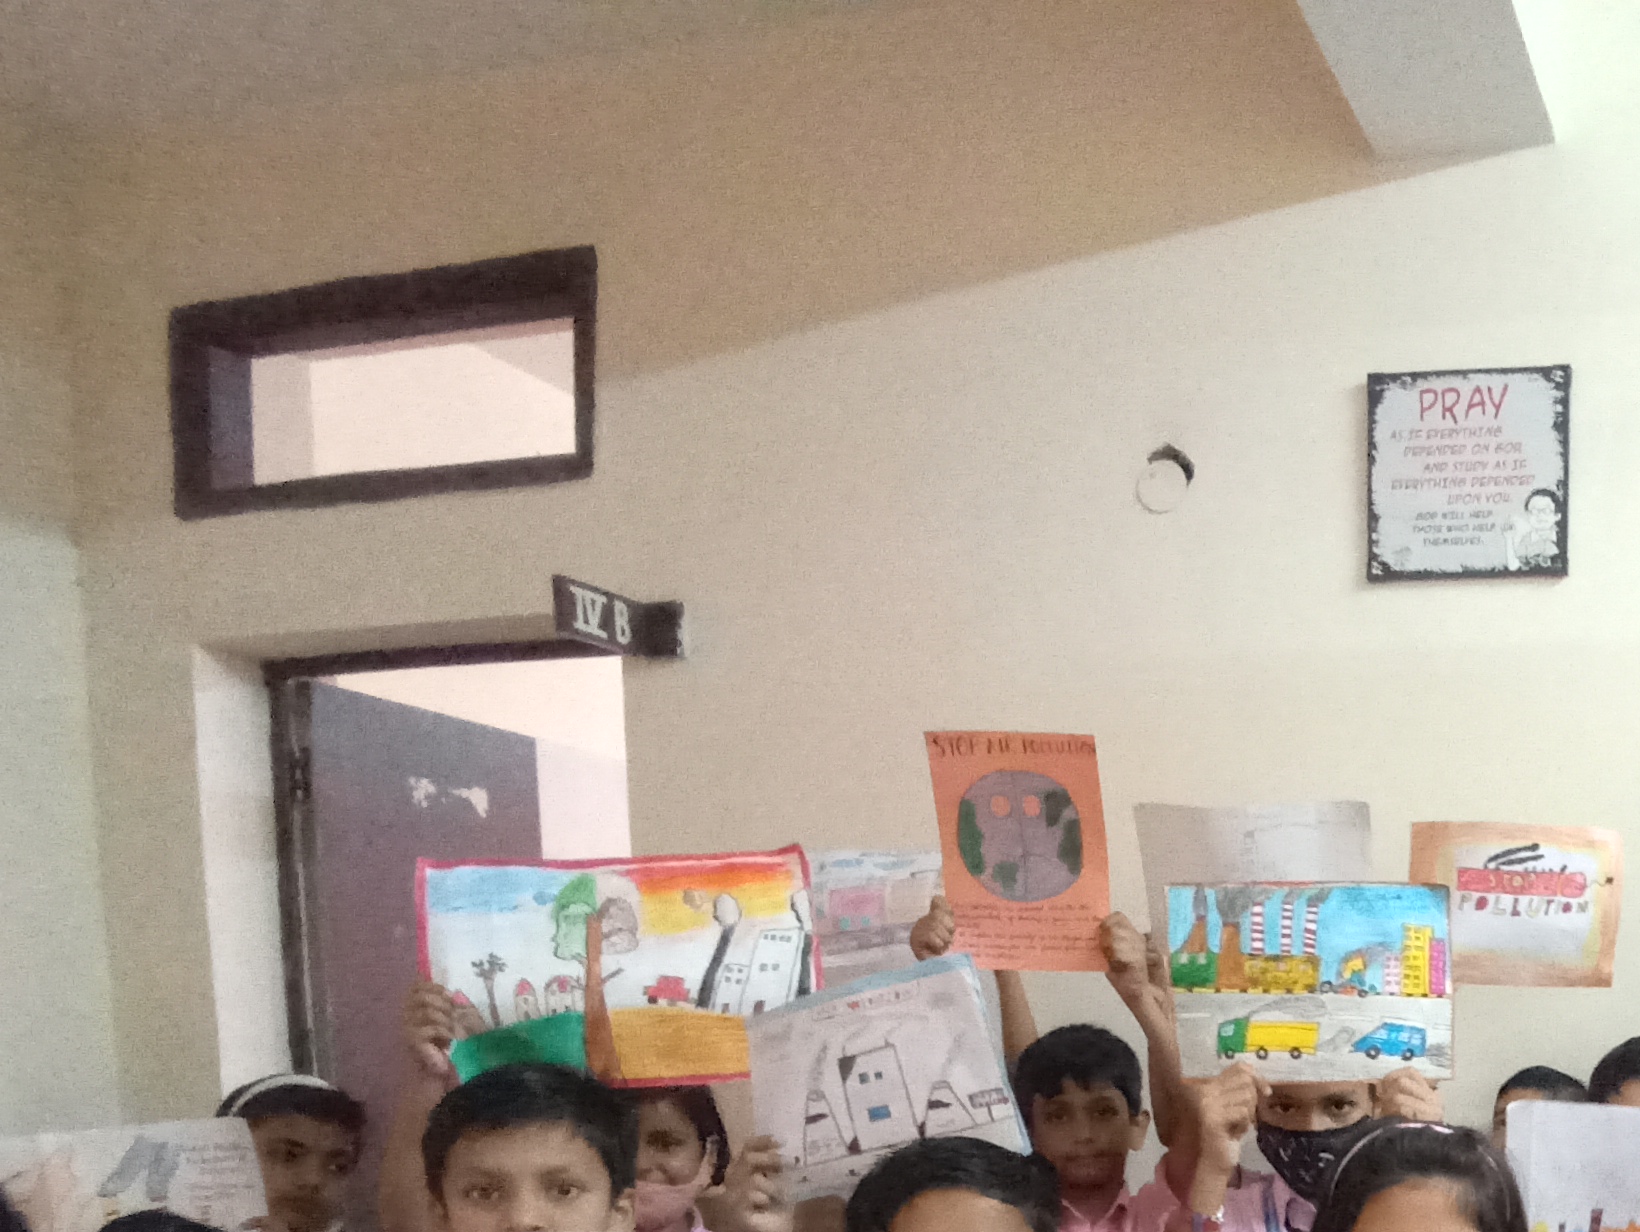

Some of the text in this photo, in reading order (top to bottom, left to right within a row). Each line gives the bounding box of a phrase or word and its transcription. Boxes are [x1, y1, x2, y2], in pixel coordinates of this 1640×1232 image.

[1419, 384, 1509, 424] PRAY
[1426, 425, 1503, 440] EVERYTHING
[1403, 444, 1468, 458] DEPENDED
[1471, 443, 1490, 456] ON
[1423, 459, 1528, 474] AND STUDY AS IF
[1390, 474, 1536, 491] EVERYTHING DEPENDED
[1446, 493, 1482, 506] UPON
[1469, 509, 1493, 520] HELP
[1472, 522, 1496, 533] HELP
[568, 584, 632, 645] IV B
